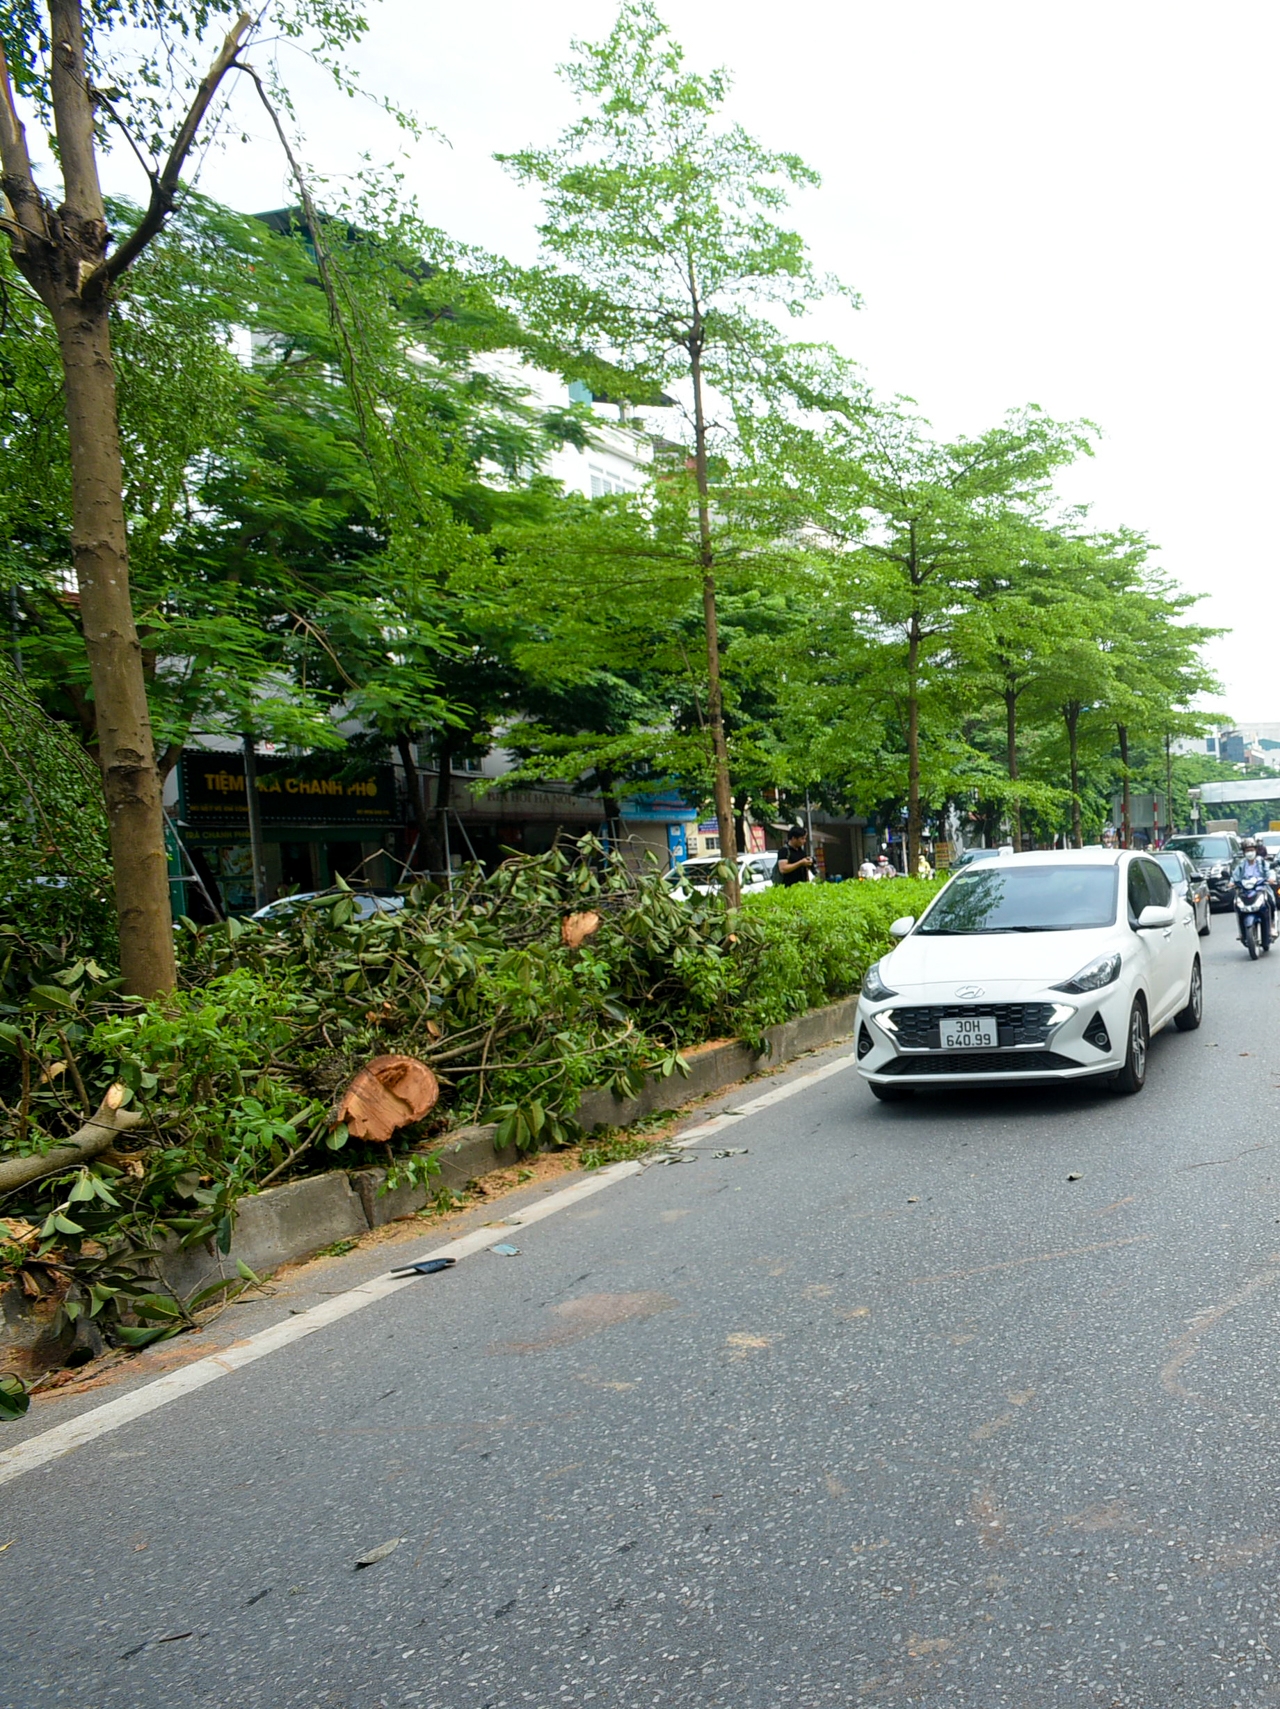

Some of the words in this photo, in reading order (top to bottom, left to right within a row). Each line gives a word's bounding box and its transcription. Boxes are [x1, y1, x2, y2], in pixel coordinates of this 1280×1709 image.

[203, 769, 246, 796] TIỆM
[284, 777, 344, 796] CHANH
[347, 775, 378, 798] PHỐ
[955, 1020, 981, 1033] 30H
[946, 1033, 991, 1047] 640.99
